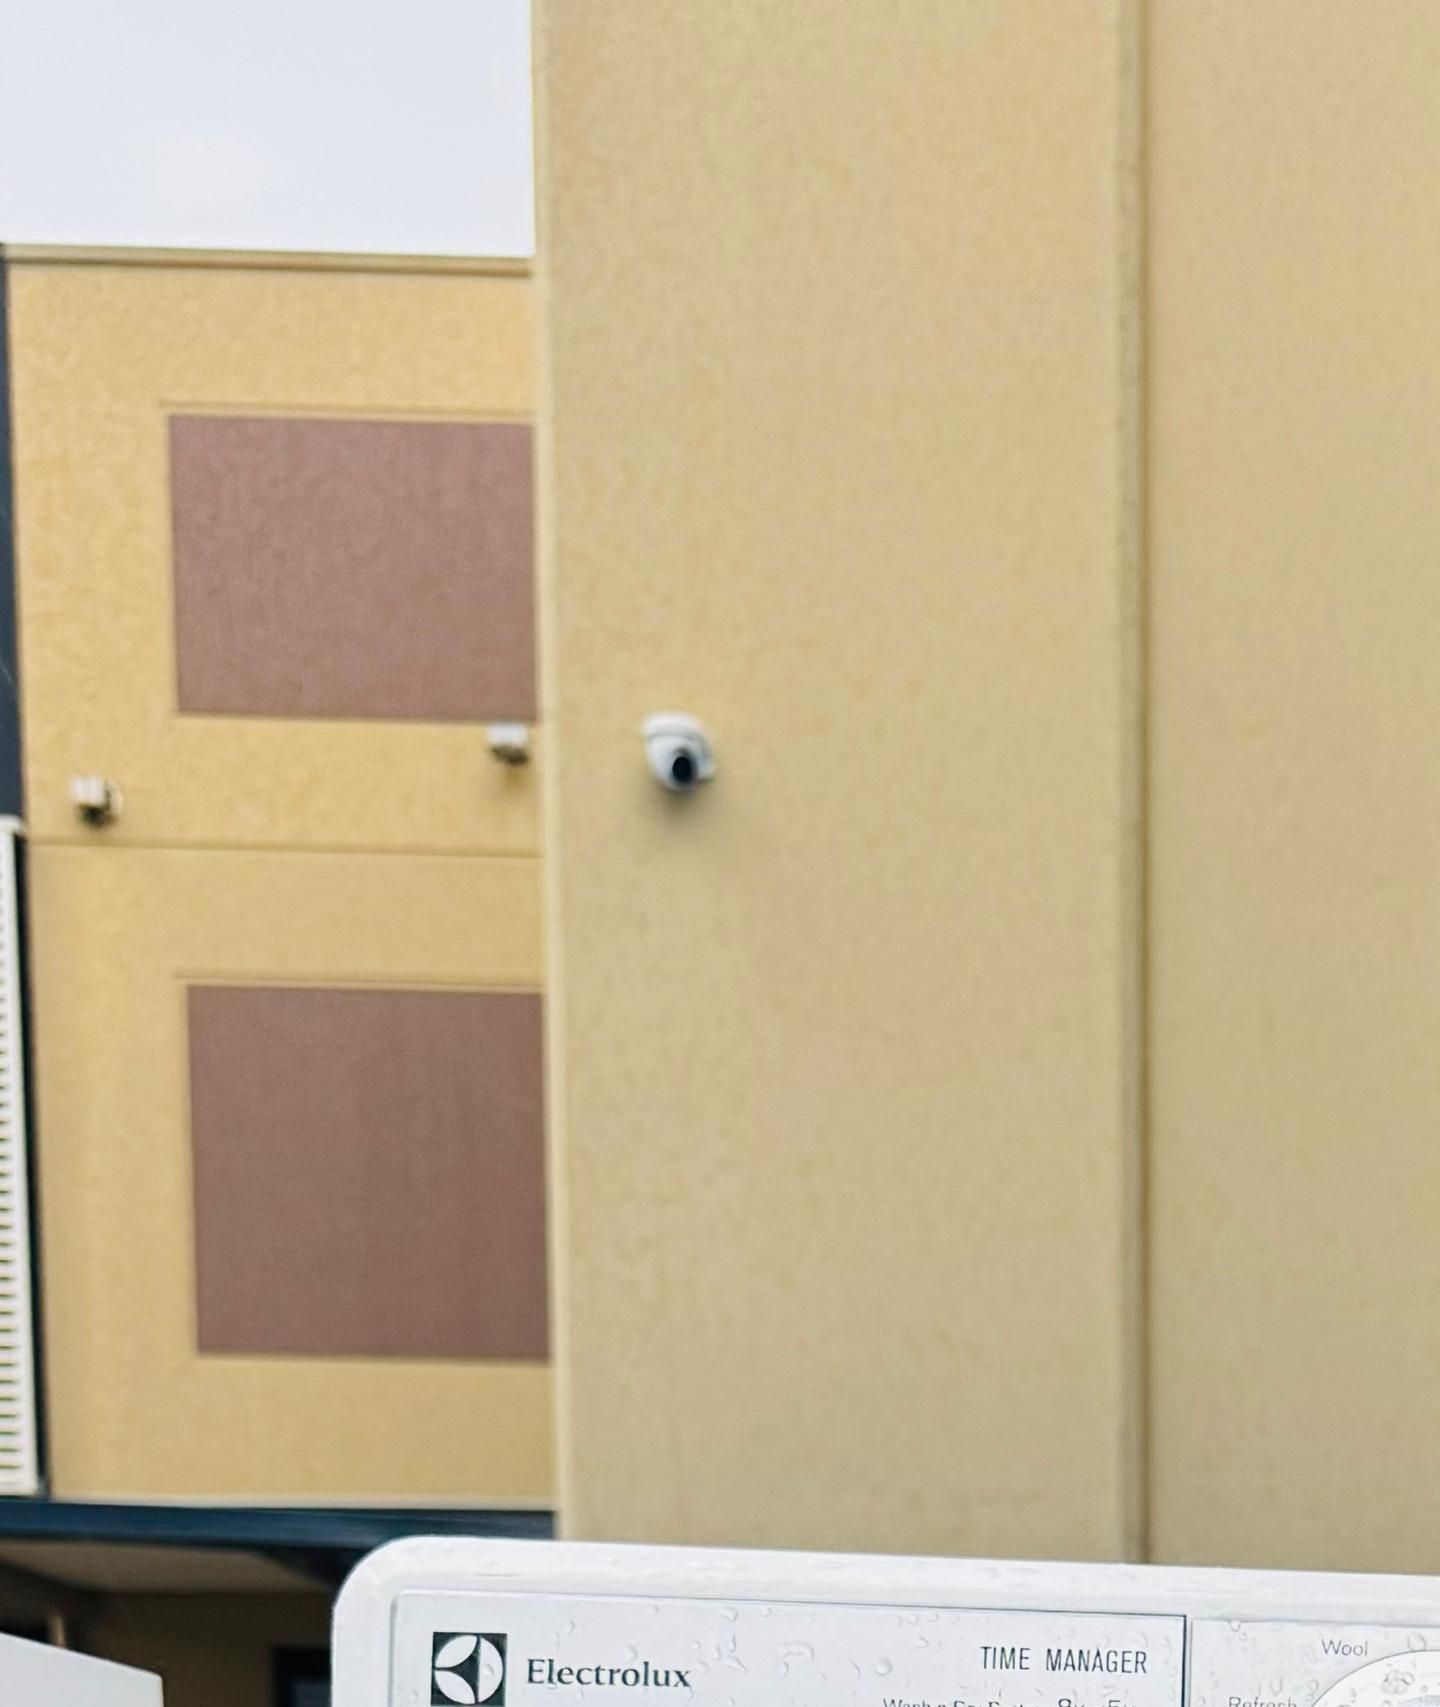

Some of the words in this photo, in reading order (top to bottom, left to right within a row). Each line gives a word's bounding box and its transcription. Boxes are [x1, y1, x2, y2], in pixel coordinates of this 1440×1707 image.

[980, 1646, 1030, 1670] TIME
[1045, 1648, 1147, 1674] MANAGER
[1321, 1638, 1369, 1657] Wool
[527, 1658, 692, 1688] Electrolux
